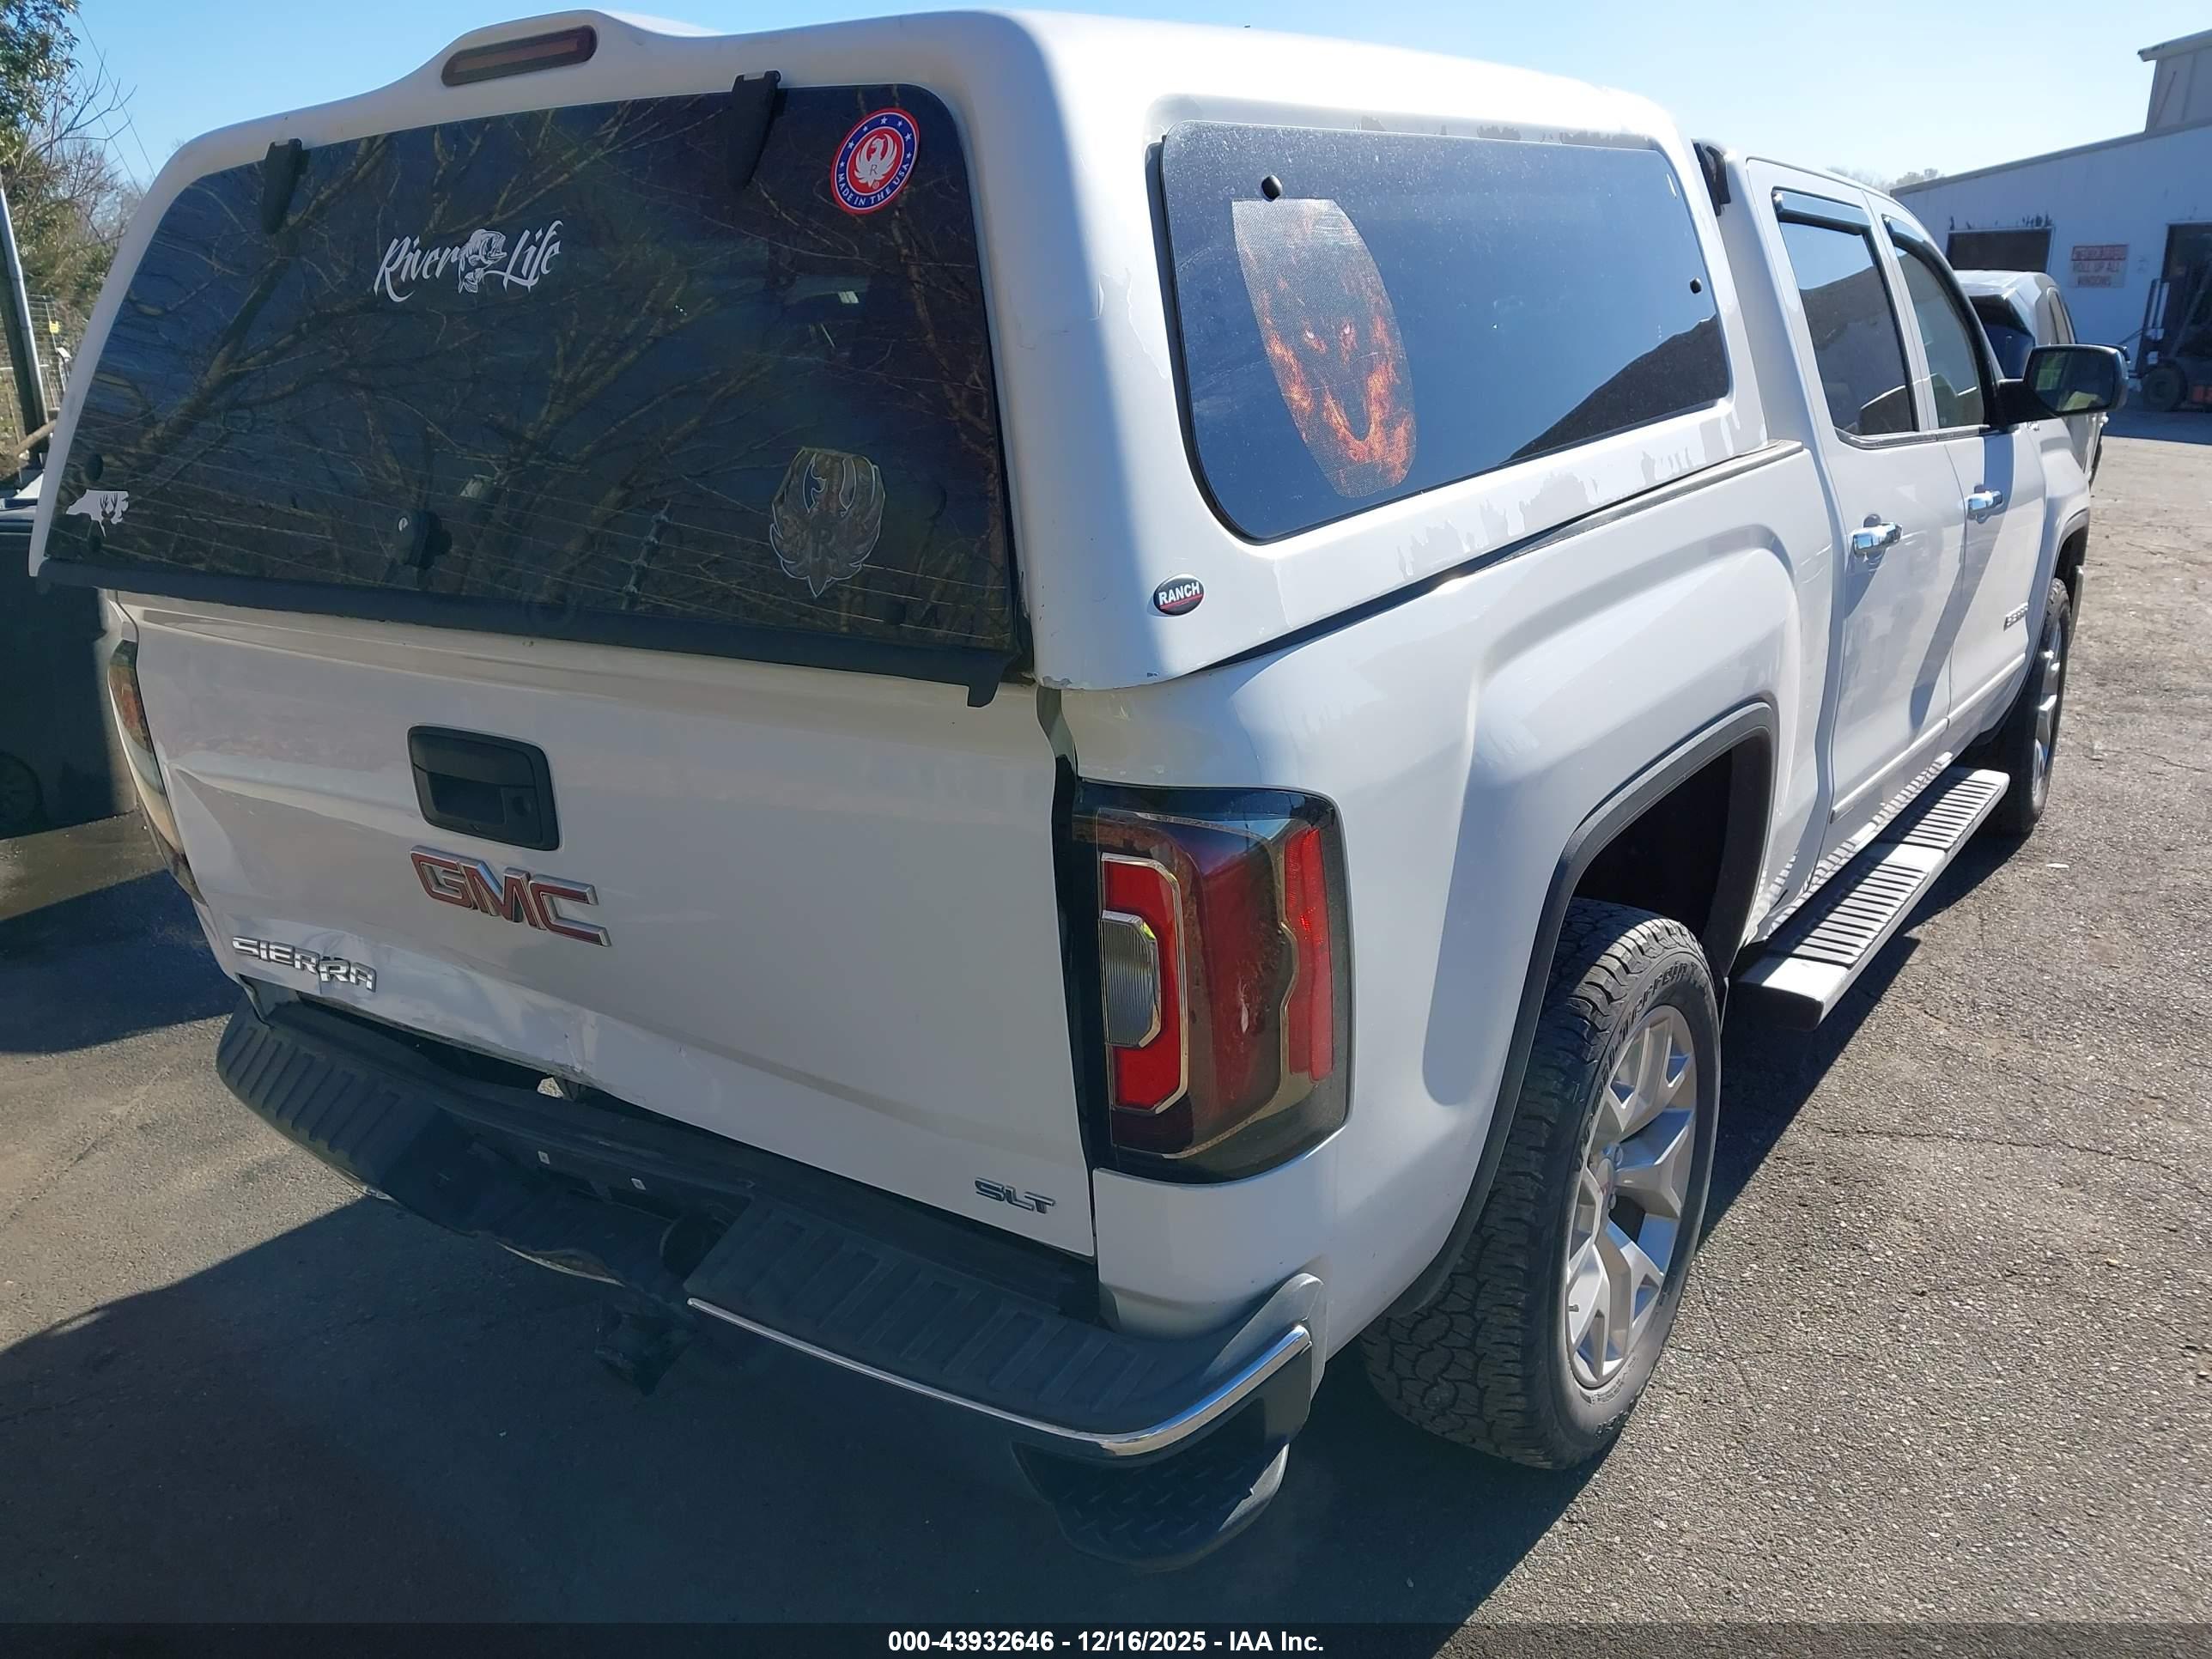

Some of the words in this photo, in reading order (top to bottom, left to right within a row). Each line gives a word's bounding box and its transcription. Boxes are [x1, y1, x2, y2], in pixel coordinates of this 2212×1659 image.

[837, 173, 854, 201] MADE
[854, 197, 866, 206] IN
[870, 187, 892, 205] THE
[894, 162, 910, 185] USA
[869, 164, 878, 176] R
[373, 234, 462, 302] River
[500, 220, 564, 294] Life
[1158, 581, 1200, 605] RANCH
[410, 844, 612, 947] GMC
[232, 935, 377, 993] SIERRA
[974, 1176, 1056, 1214] SLT
